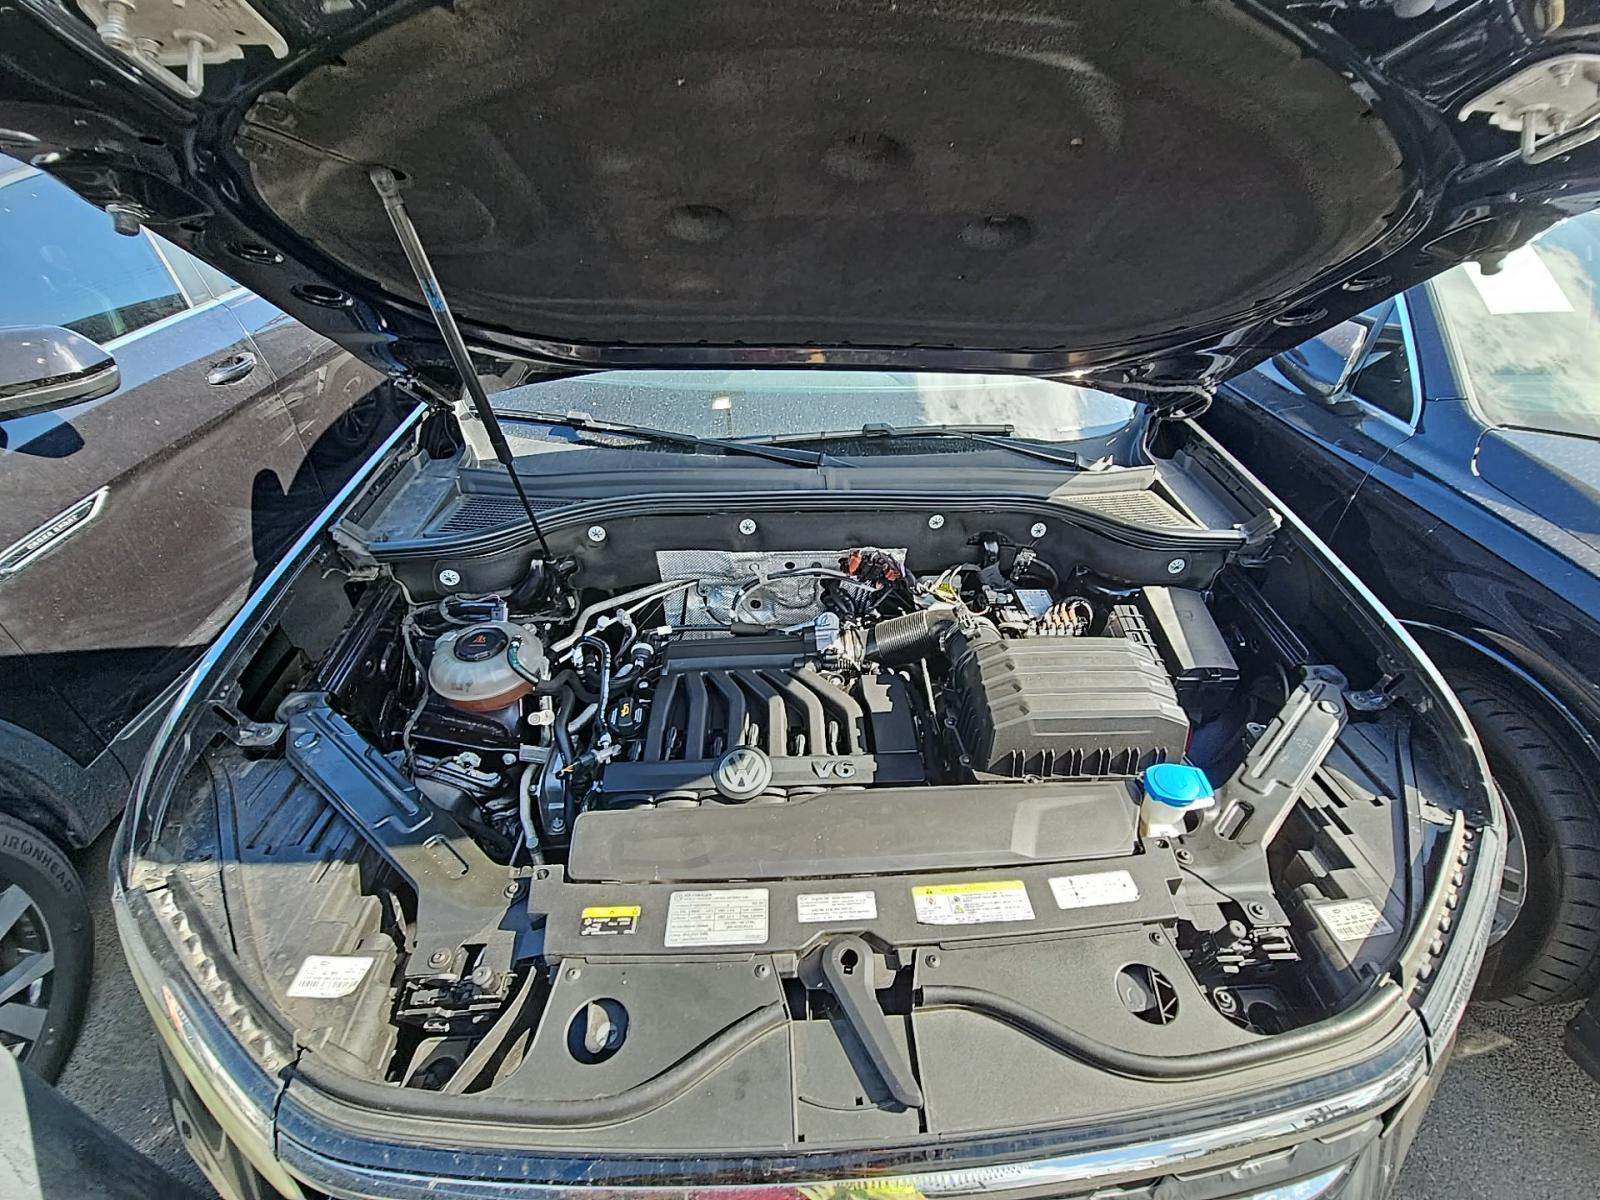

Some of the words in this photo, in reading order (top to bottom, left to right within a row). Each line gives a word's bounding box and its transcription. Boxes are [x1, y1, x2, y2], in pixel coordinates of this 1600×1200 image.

[722, 750, 764, 792] VW
[811, 760, 856, 779] V6
[2, 833, 75, 892] IRONHEAD
